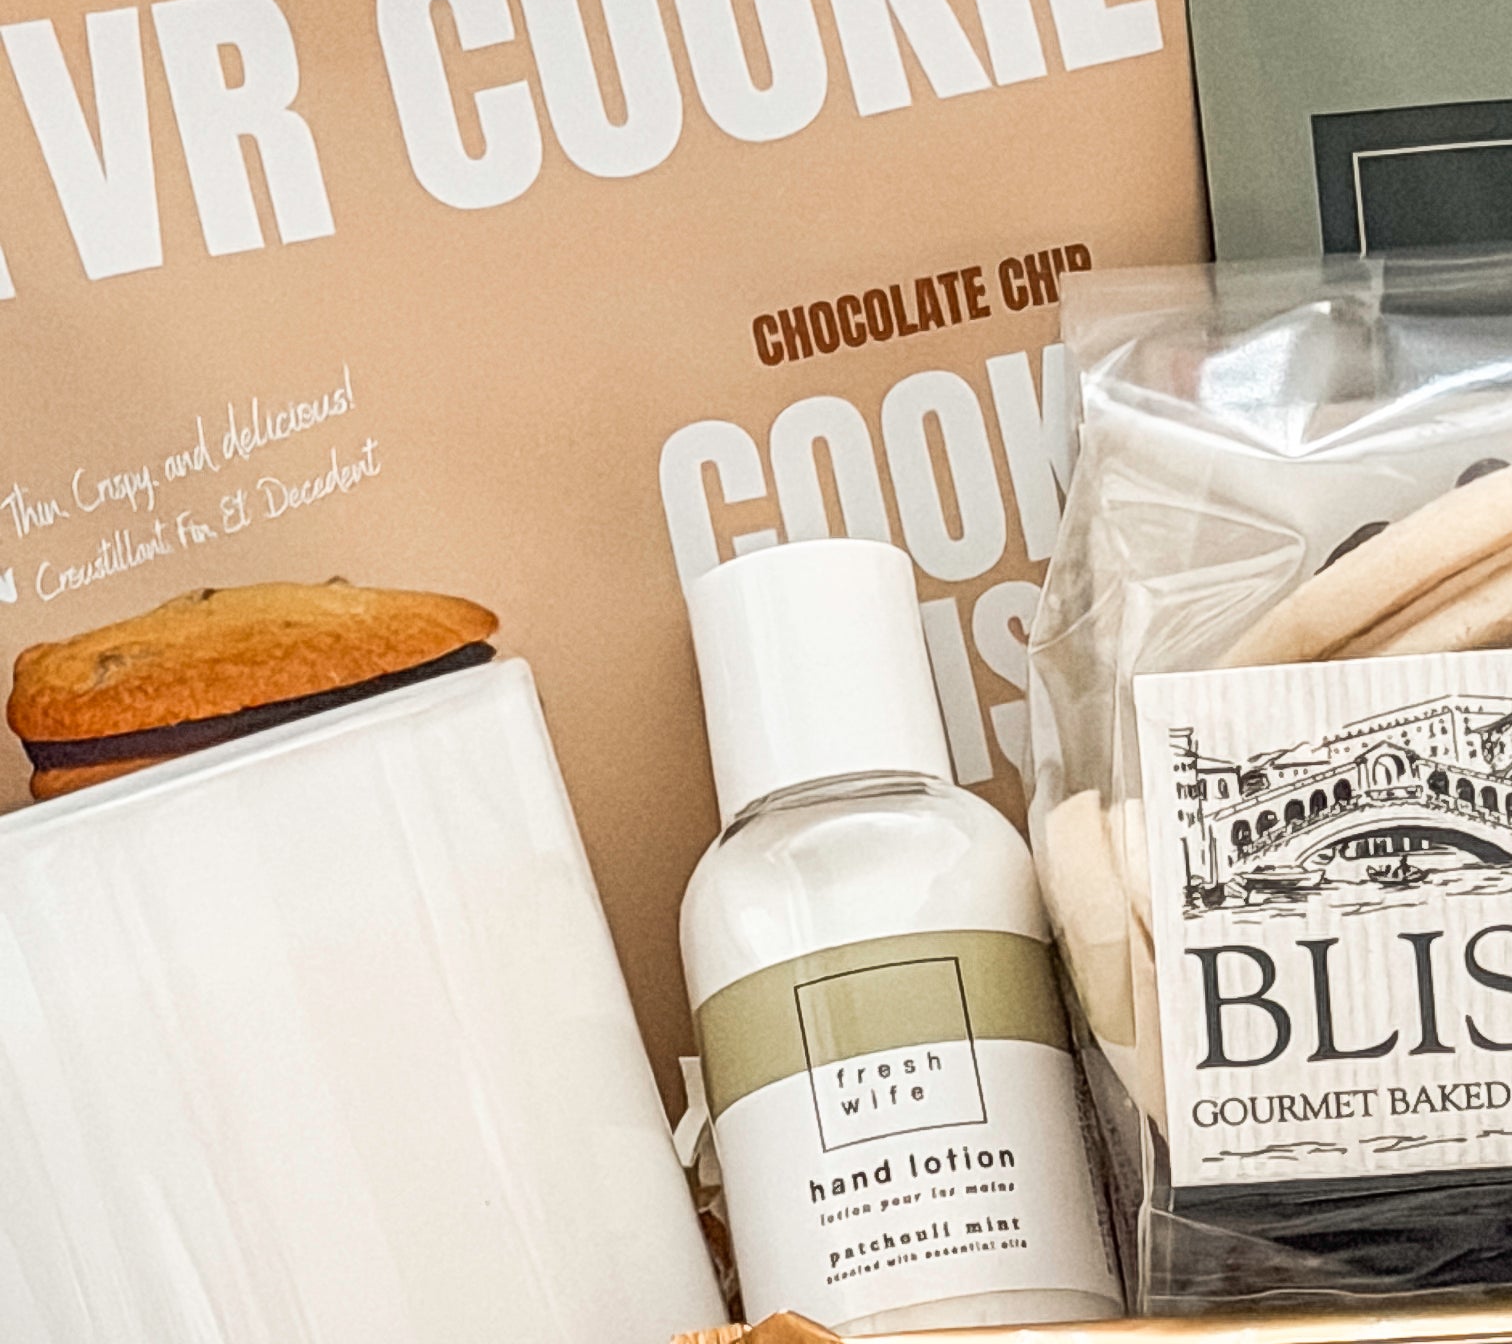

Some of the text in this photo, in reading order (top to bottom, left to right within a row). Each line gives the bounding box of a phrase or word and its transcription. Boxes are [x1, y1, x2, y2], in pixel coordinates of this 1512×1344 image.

[752, 265, 992, 366] CHOCOLATE
[165, 416, 219, 482] and
[222, 364, 355, 461] delicious!
[837, 1052, 942, 1088] fresh
[842, 1085, 925, 1116] wife
[1192, 1089, 1378, 1127] GOURMET
[1389, 1081, 1512, 1115] BAKED
[809, 1147, 1015, 1204] hand lotion
[829, 1216, 1020, 1268] patchouli mint
